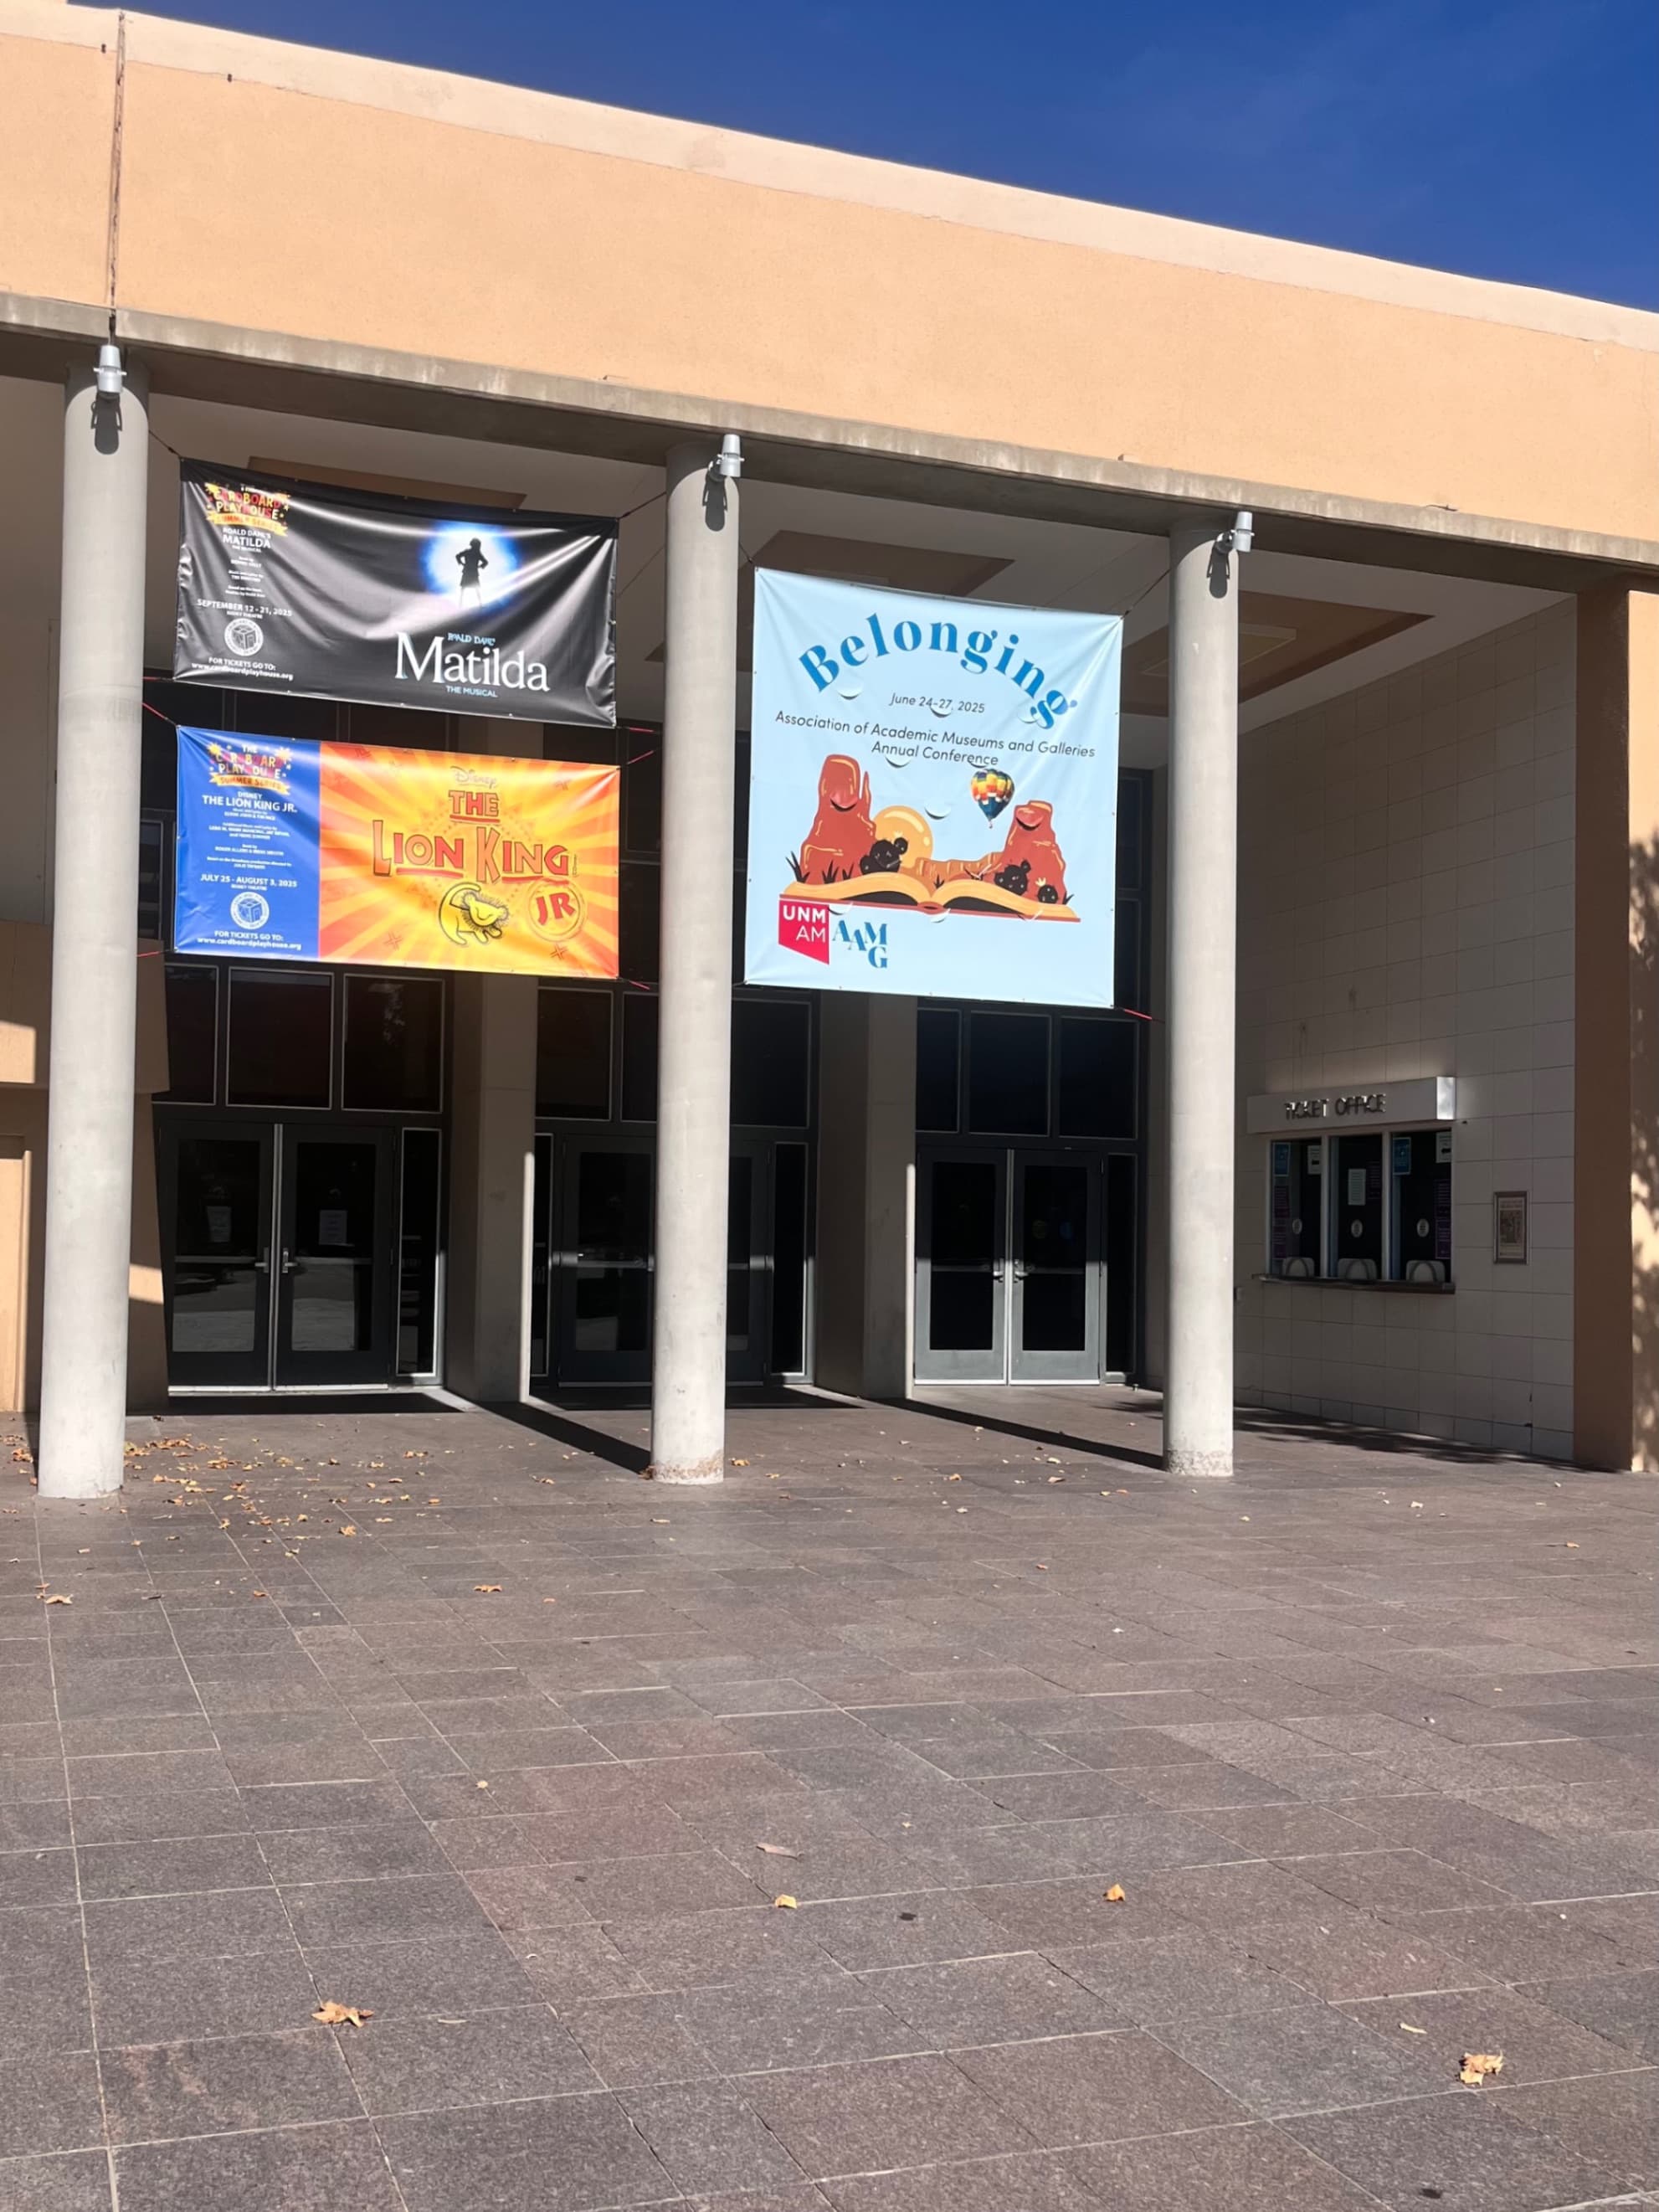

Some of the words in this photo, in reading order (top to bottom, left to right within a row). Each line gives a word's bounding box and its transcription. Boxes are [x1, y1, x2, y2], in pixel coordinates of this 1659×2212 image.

[223, 527, 246, 536] ROALD
[223, 534, 271, 548] MATILDA
[198, 599, 243, 611] SEPTEMBER
[260, 606, 272, 615] 21,
[273, 608, 293, 617] 2025
[223, 658, 251, 667] TICKETS
[395, 631, 550, 692] Matilda
[799, 612, 1077, 730] Belonging
[445, 686, 461, 694] THE
[462, 687, 498, 697] MUSICAL
[889, 692, 916, 707] June
[958, 701, 985, 713] 2025
[775, 710, 850, 733] Association
[854, 722, 870, 734] of
[871, 723, 938, 743] Academic
[942, 731, 1004, 749] Museums
[1009, 741, 1034, 752] and
[1038, 741, 1096, 757] Galleries
[871, 741, 919, 757] Annual
[922, 747, 999, 765] Conference
[450, 765, 497, 789] Disney
[202, 795, 223, 805] THE
[226, 796, 251, 808] LION
[254, 800, 280, 811] KING
[281, 802, 298, 813] JR.
[449, 790, 500, 817] THE
[372, 820, 464, 877] LION
[476, 826, 569, 884] KING
[200, 873, 219, 882] JULY
[236, 877, 268, 885] AUGUST
[536, 892, 575, 926] JR
[783, 905, 826, 923] UNM
[230, 931, 258, 939] TICKETS
[796, 925, 826, 943] AM
[198, 938, 302, 951] www.cardboardplayhouse.org
[1284, 1098, 1329, 1120] TICKET
[1335, 1093, 1386, 1115] OFFICE
